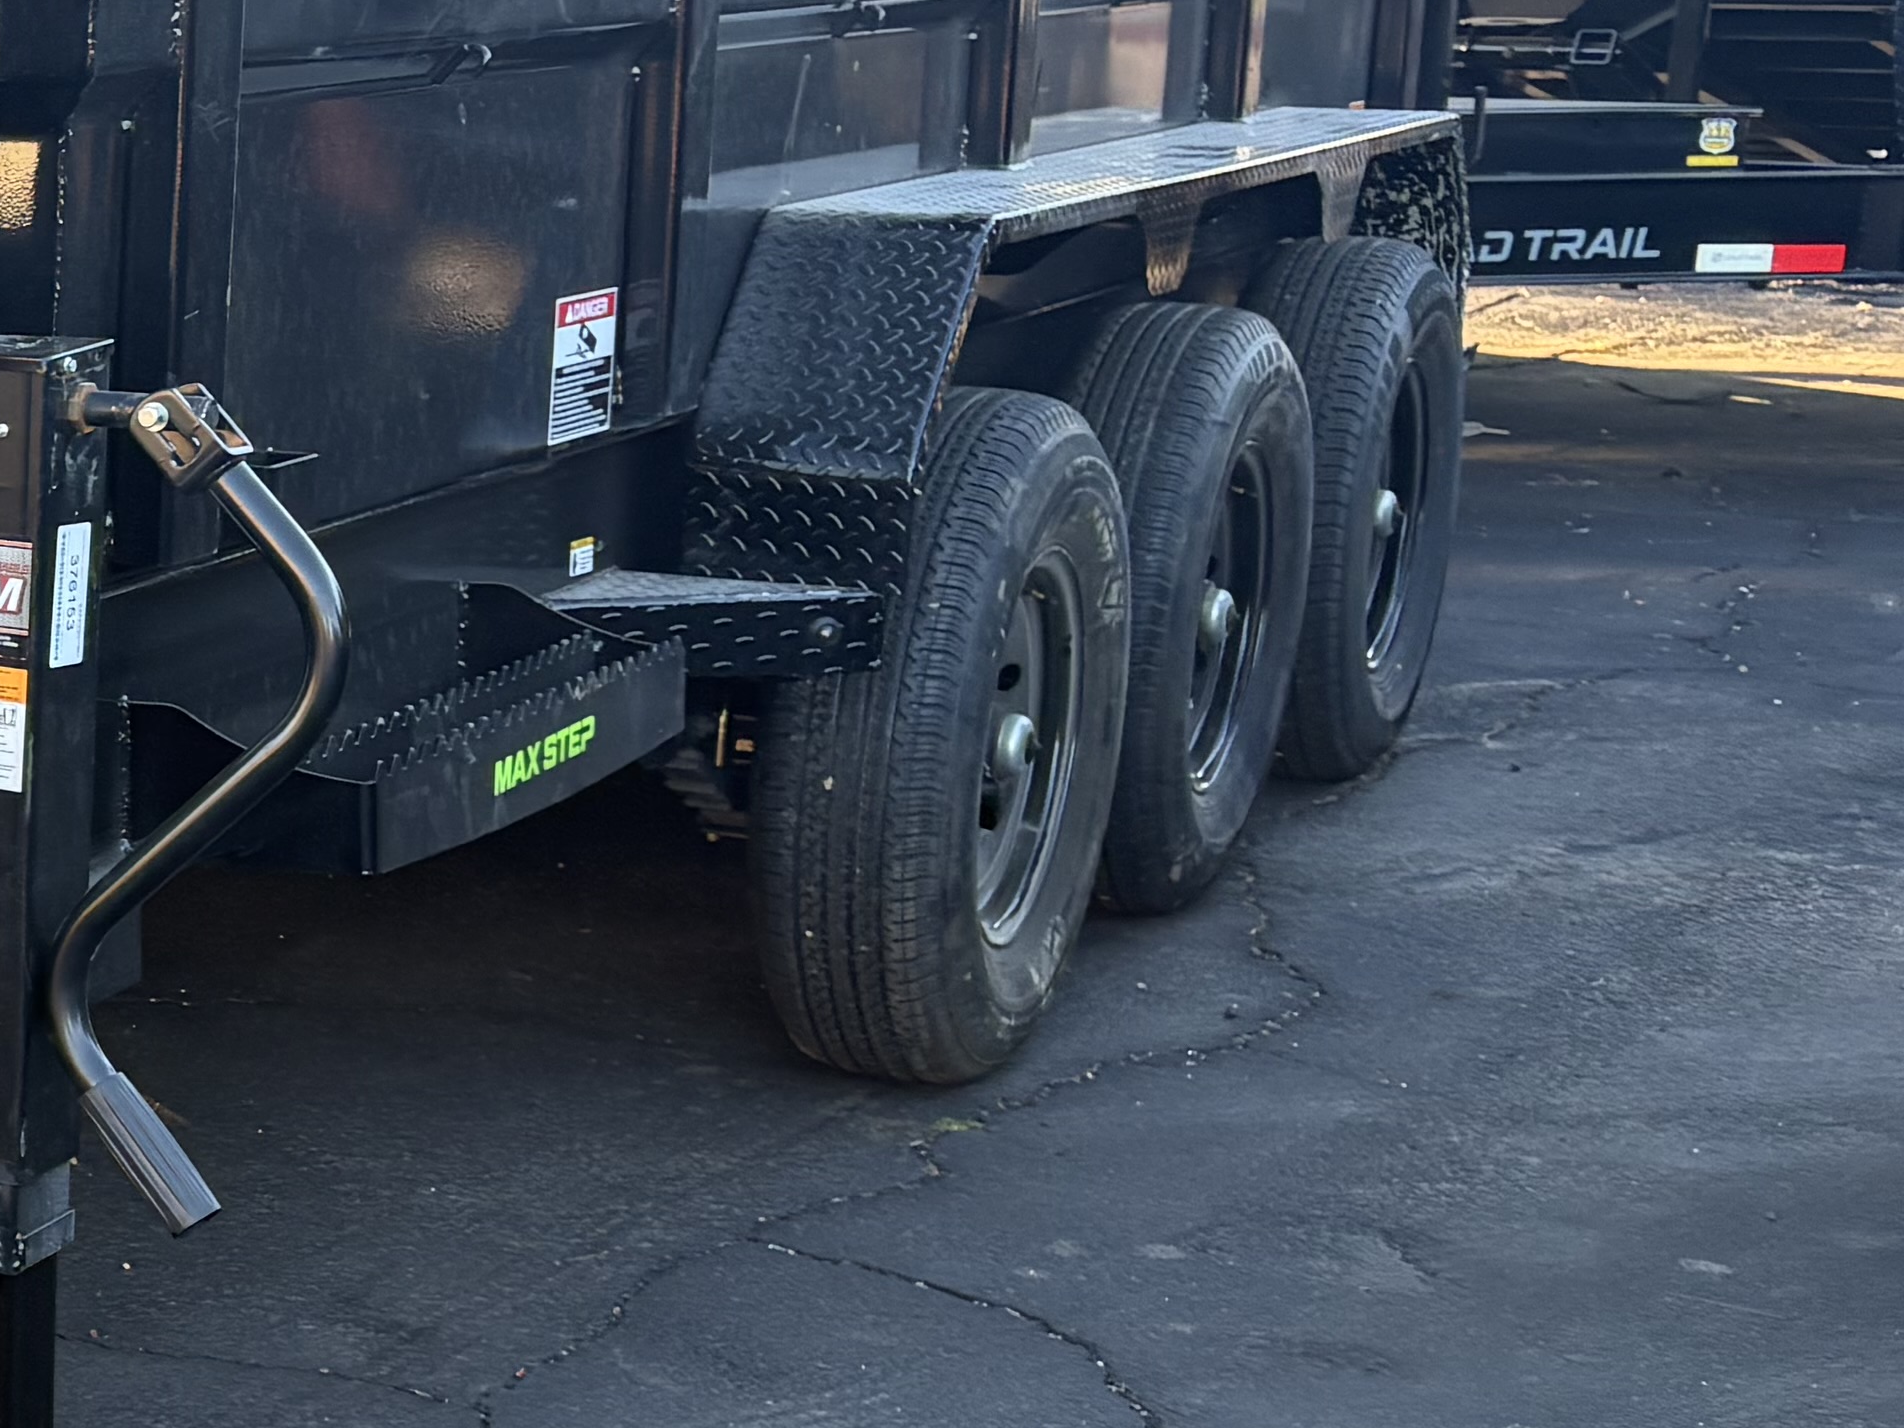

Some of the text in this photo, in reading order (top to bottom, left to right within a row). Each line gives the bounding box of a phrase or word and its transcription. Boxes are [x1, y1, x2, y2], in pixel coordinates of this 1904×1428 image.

[1523, 226, 1661, 262] TRAIL
[494, 715, 596, 797] MAX STEP
